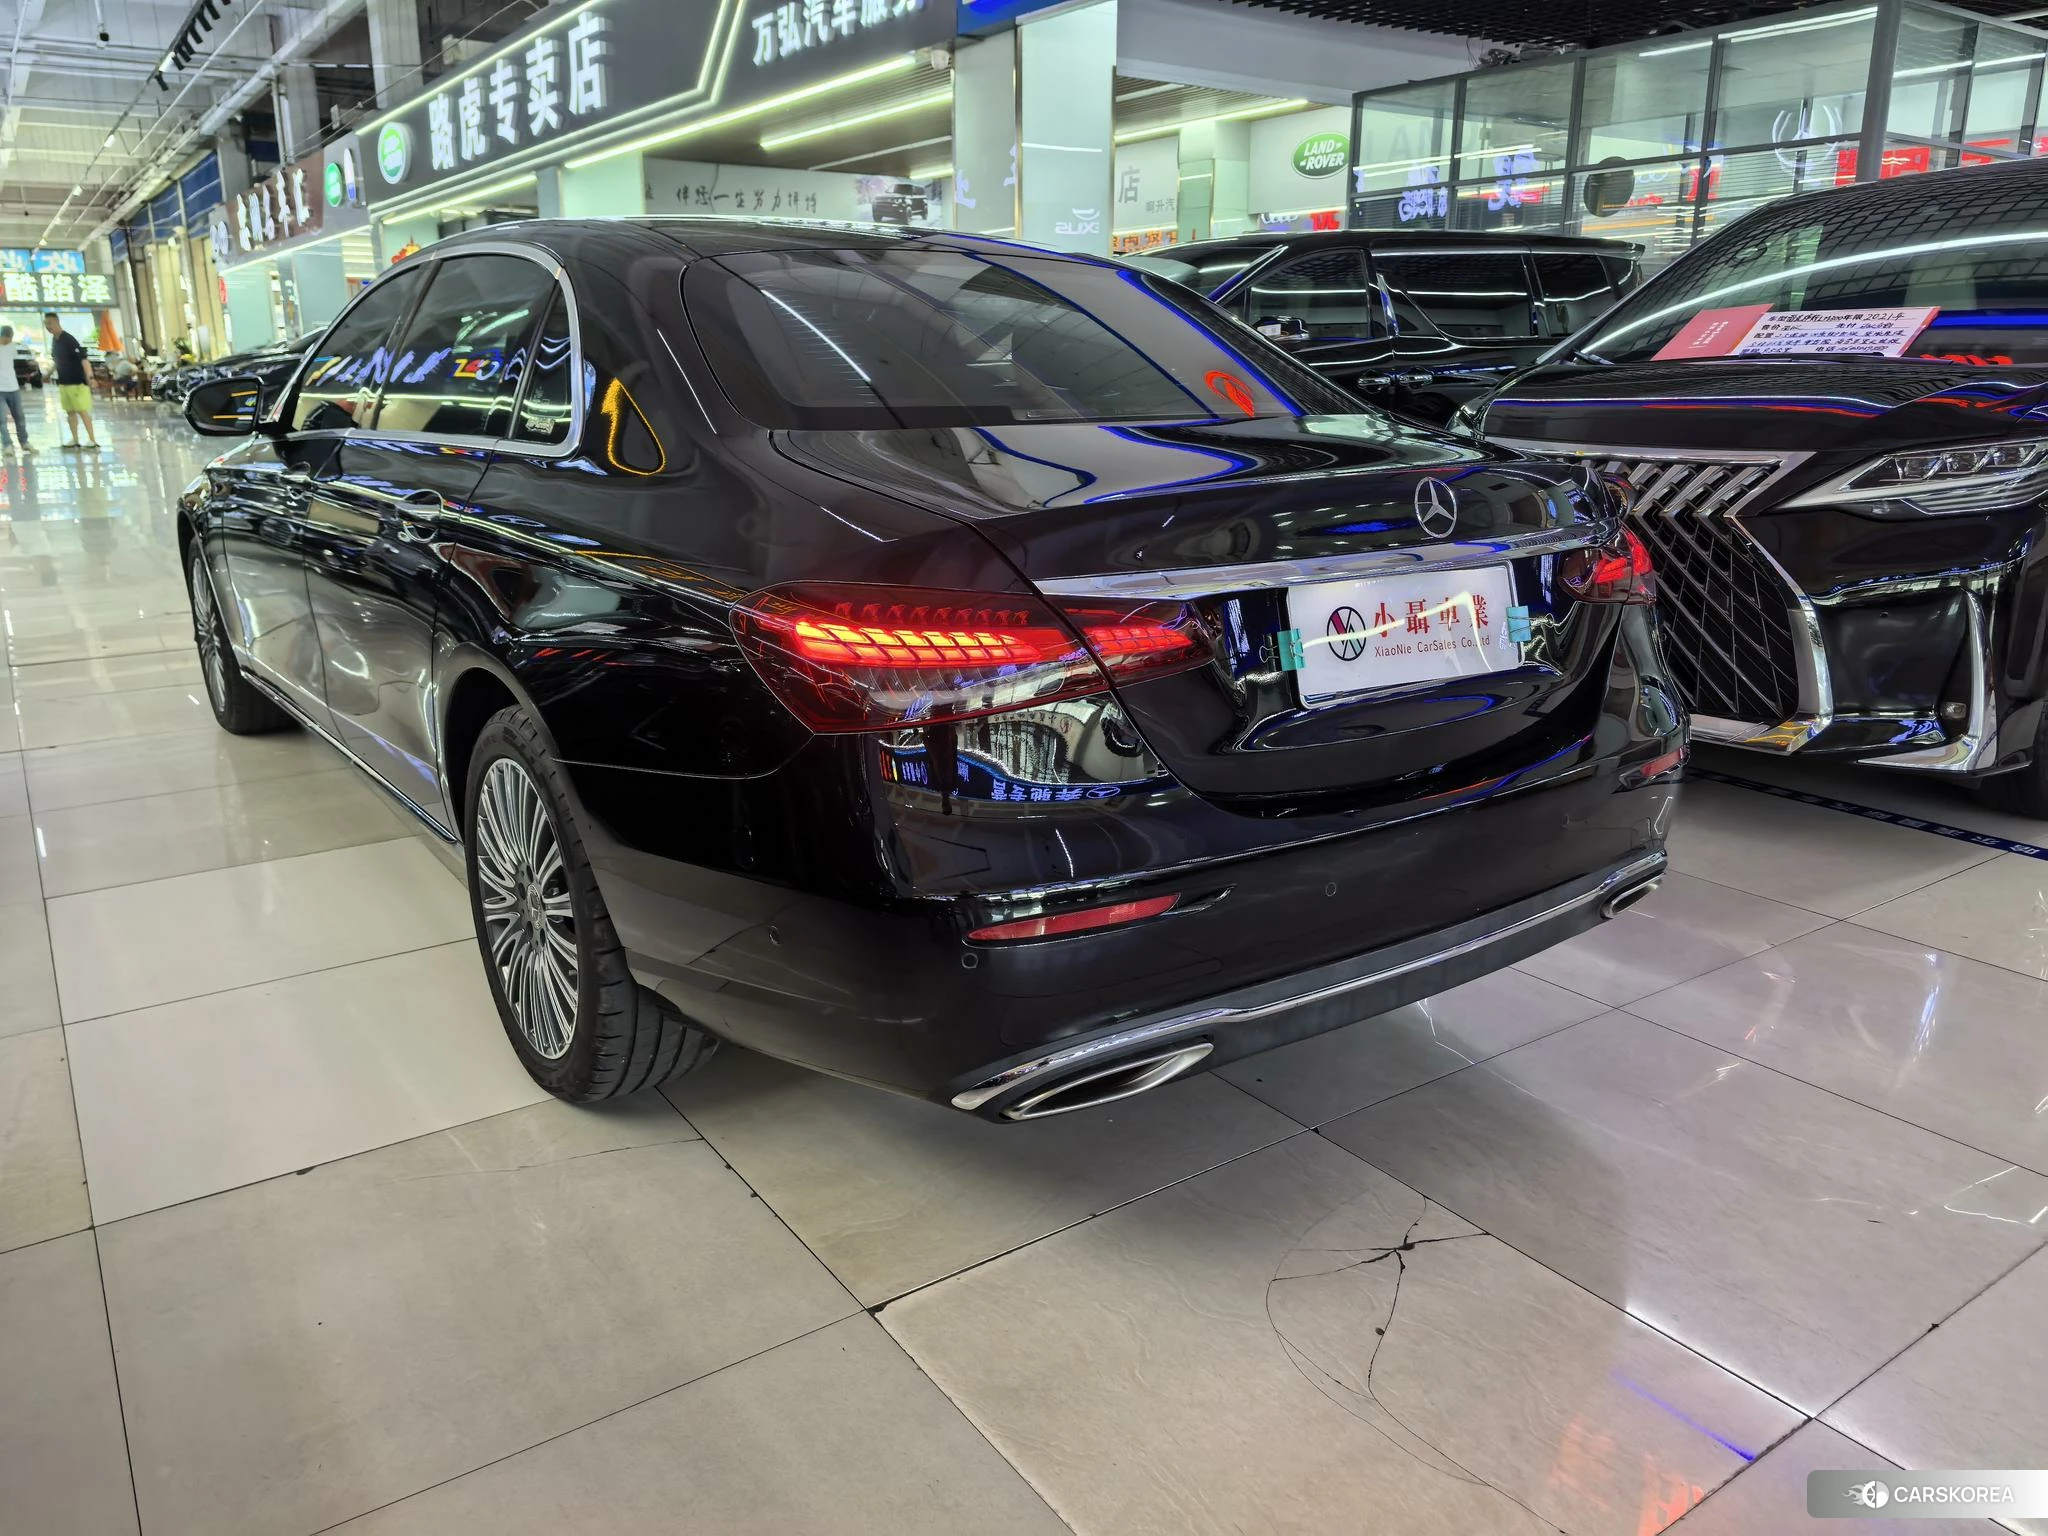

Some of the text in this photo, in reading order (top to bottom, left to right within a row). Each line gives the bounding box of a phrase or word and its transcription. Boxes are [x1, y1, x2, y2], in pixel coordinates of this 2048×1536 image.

[428, 11, 607, 171] 路虎专卖店
[1304, 140, 1335, 157] LAND
[1306, 152, 1344, 170] ROVER
[1118, 166, 1141, 204] 店
[3, 272, 112, 303] 酷路泽
[1374, 644, 1412, 657] XiaoNie
[1417, 640, 1457, 653] CarSales
